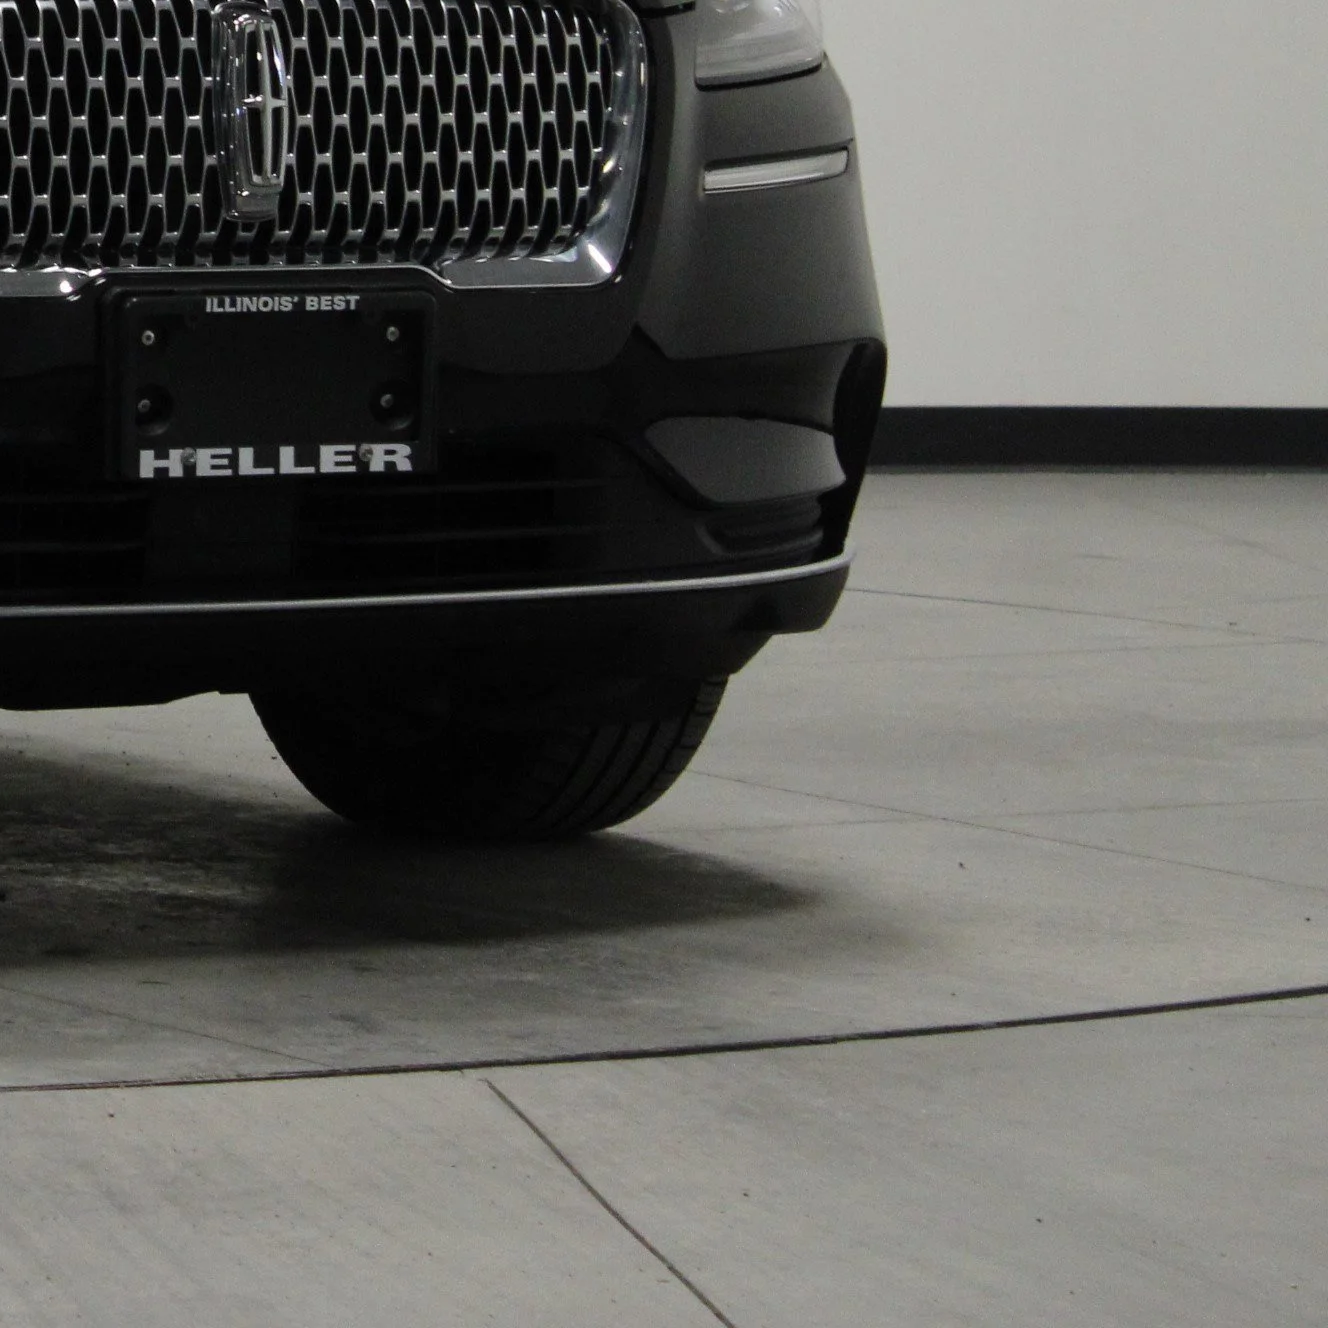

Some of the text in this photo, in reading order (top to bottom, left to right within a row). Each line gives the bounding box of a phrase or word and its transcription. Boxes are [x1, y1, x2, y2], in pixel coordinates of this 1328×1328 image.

[205, 295, 361, 313] ILLINOIS' BEST
[139, 443, 413, 478] HELLER
